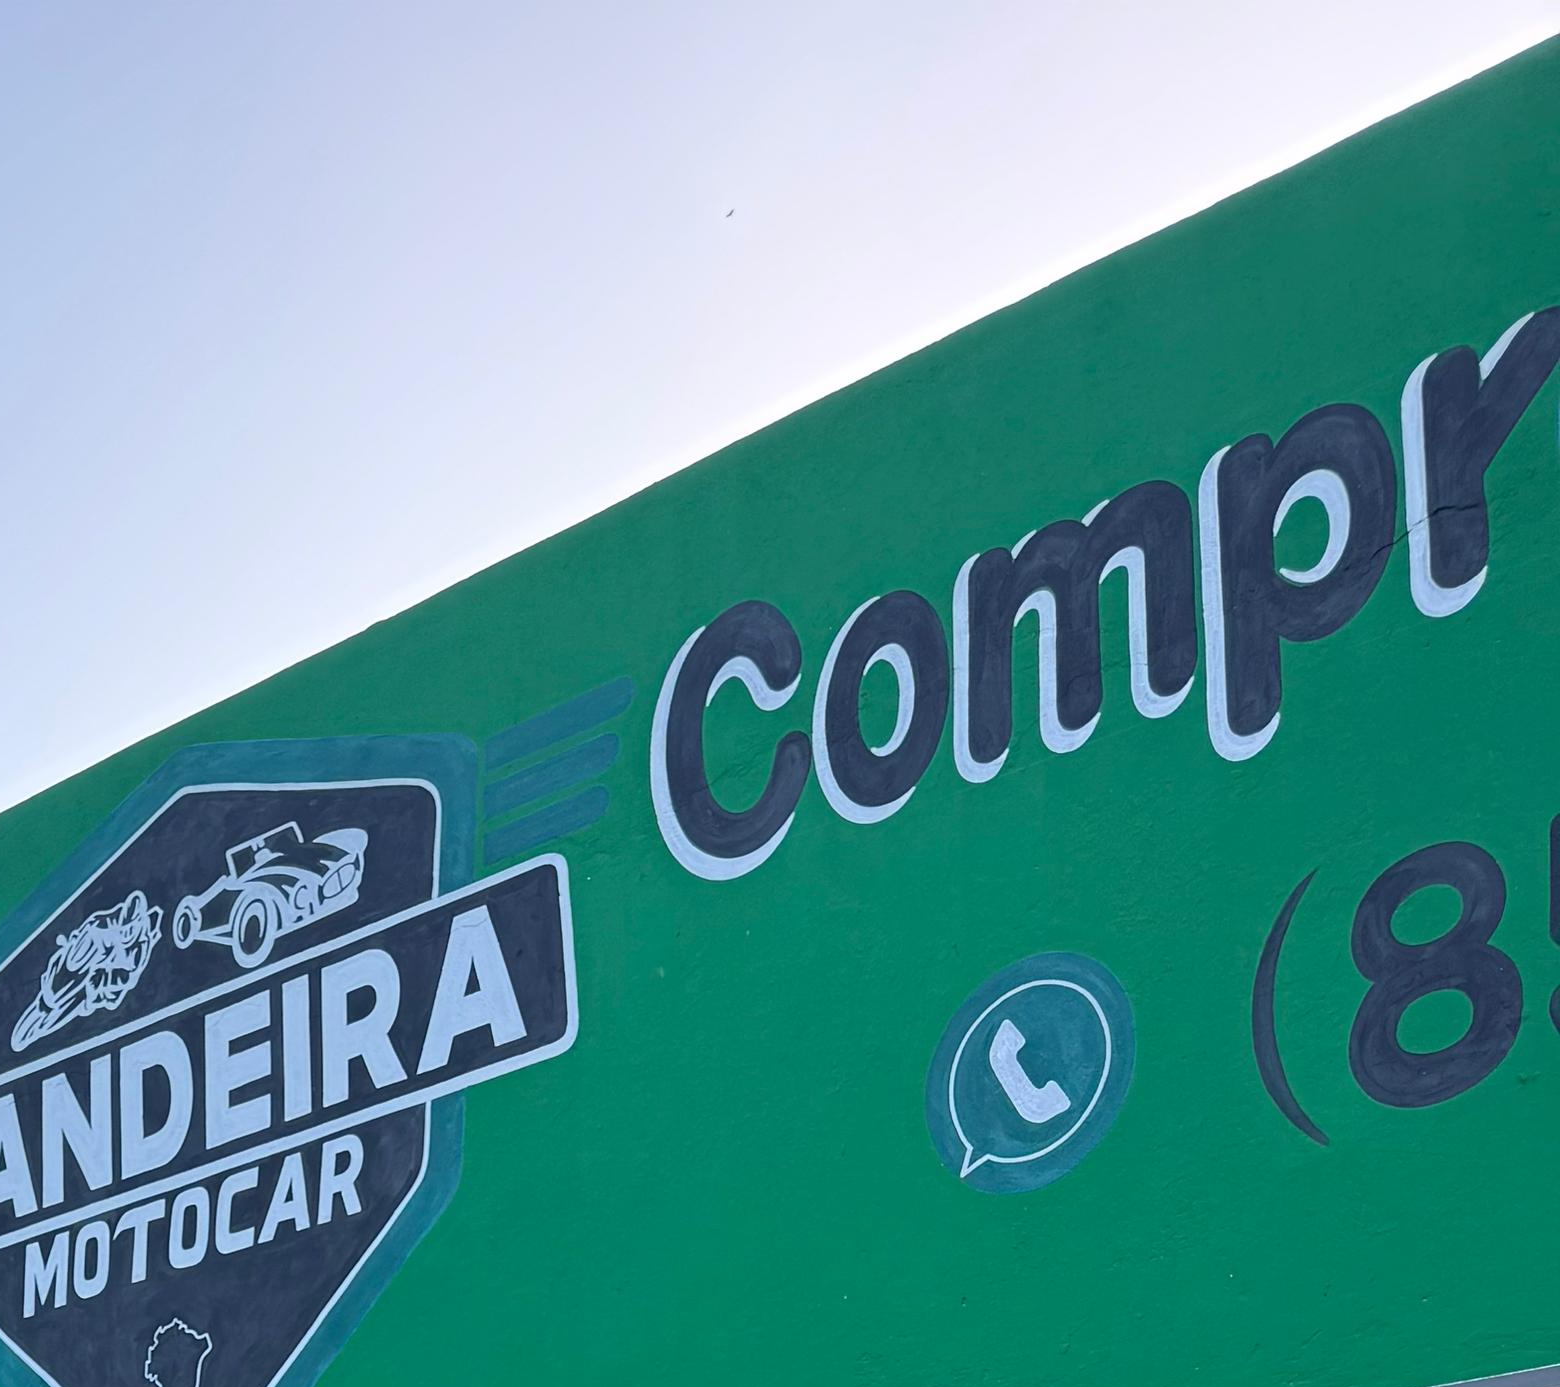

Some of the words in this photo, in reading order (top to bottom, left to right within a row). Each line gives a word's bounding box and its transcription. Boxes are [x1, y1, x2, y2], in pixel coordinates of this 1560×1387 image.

[650, 305, 1560, 881] Compr
[1251, 812, 1560, 1147] (8
[22, 1134, 363, 1319] MOTOCAR
